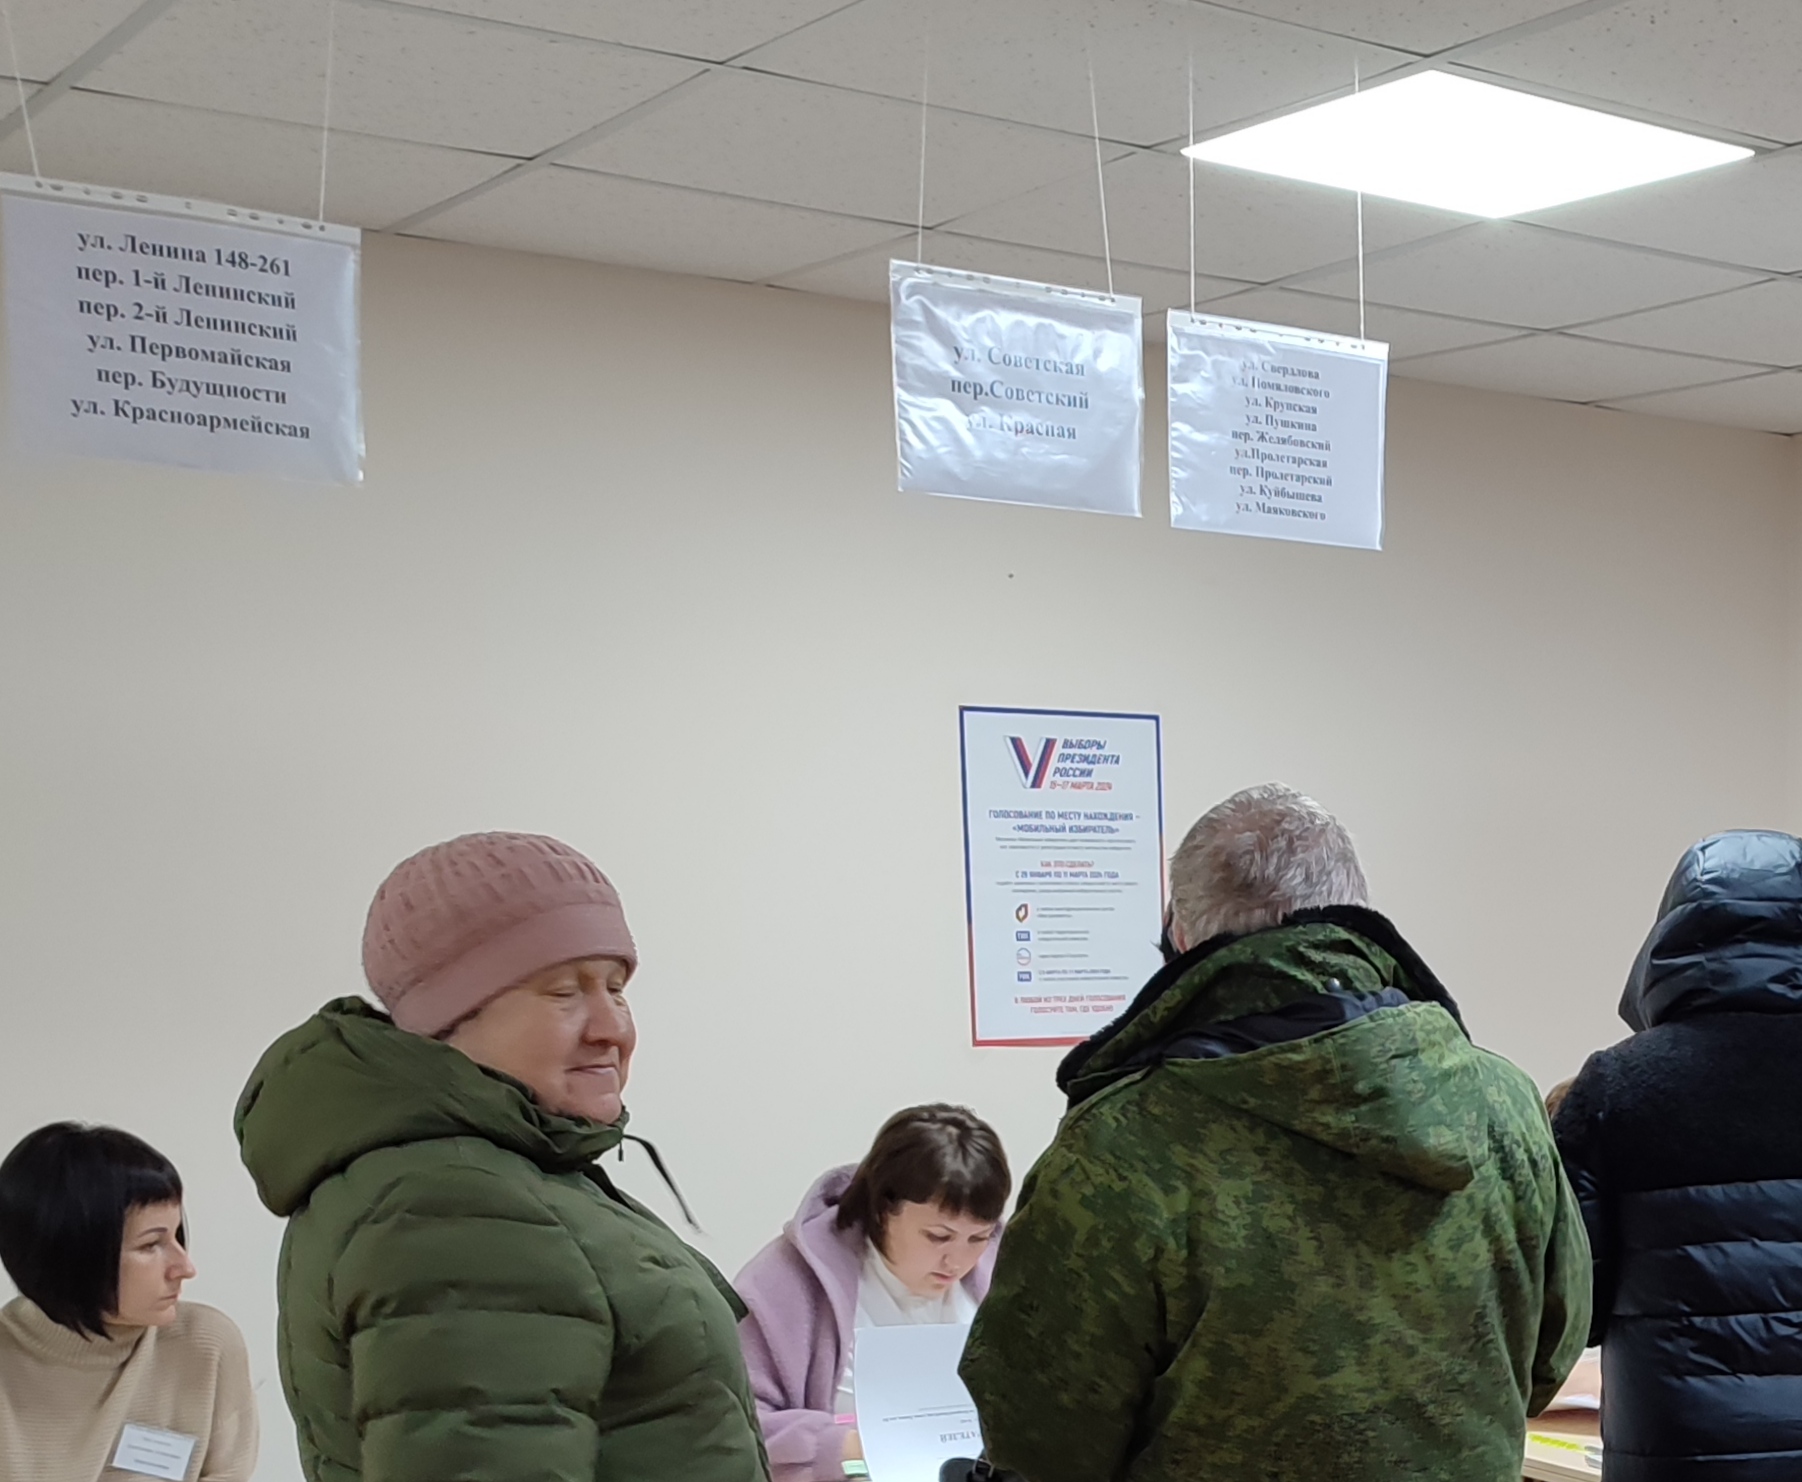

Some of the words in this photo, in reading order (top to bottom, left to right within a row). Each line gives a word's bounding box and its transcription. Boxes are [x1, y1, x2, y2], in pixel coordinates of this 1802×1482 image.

[77, 231, 112, 251] ул.
[119, 235, 206, 263] Ленина
[214, 248, 291, 277] 148-261
[77, 264, 123, 289] пер.
[132, 269, 166, 291] 1-й
[173, 275, 296, 310] Ленинский
[78, 297, 125, 322] пер.
[133, 302, 167, 324] 2-й
[175, 308, 297, 342] Ленинский
[86, 332, 122, 352] ул.
[129, 335, 291, 373] Первомайская
[953, 345, 980, 364] ул.
[988, 347, 1085, 376] Советская
[1261, 362, 1320, 380] Свердлова
[97, 366, 143, 390] пер.
[151, 370, 286, 404] Будущности
[1245, 395, 1261, 408] ул.
[1264, 397, 1318, 414] Крупская
[70, 396, 106, 417] ул.
[113, 399, 311, 439] Красноармейская
[999, 413, 1077, 439] Красная
[1245, 413, 1261, 426] ул.
[1265, 414, 1317, 432] Пушкина
[1232, 430, 1253, 443] пер.
[1256, 431, 1331, 451] Желябовский
[1229, 465, 1252, 477] пер.
[1255, 466, 1333, 486] Пролетарский
[1239, 483, 1255, 497] ул.
[1259, 484, 1323, 503] Куйбышева
[1235, 501, 1251, 513] ул.
[1255, 503, 1326, 521] Маяковского
[1062, 738, 1107, 750] ВЫБОРЫ
[1057, 753, 1120, 765] ПРЕЗИДЕНТА
[1053, 767, 1094, 778] РОССИИ
[989, 810, 1043, 819] ГОЛОСОВАНИЕ
[1046, 811, 1056, 819] ПО
[1058, 811, 1081, 820] МЕСТУ
[1083, 812, 1133, 822] НАХОЖДЕНИЯ
[940, 1431, 980, 1443] АТЕЛЕЙ
